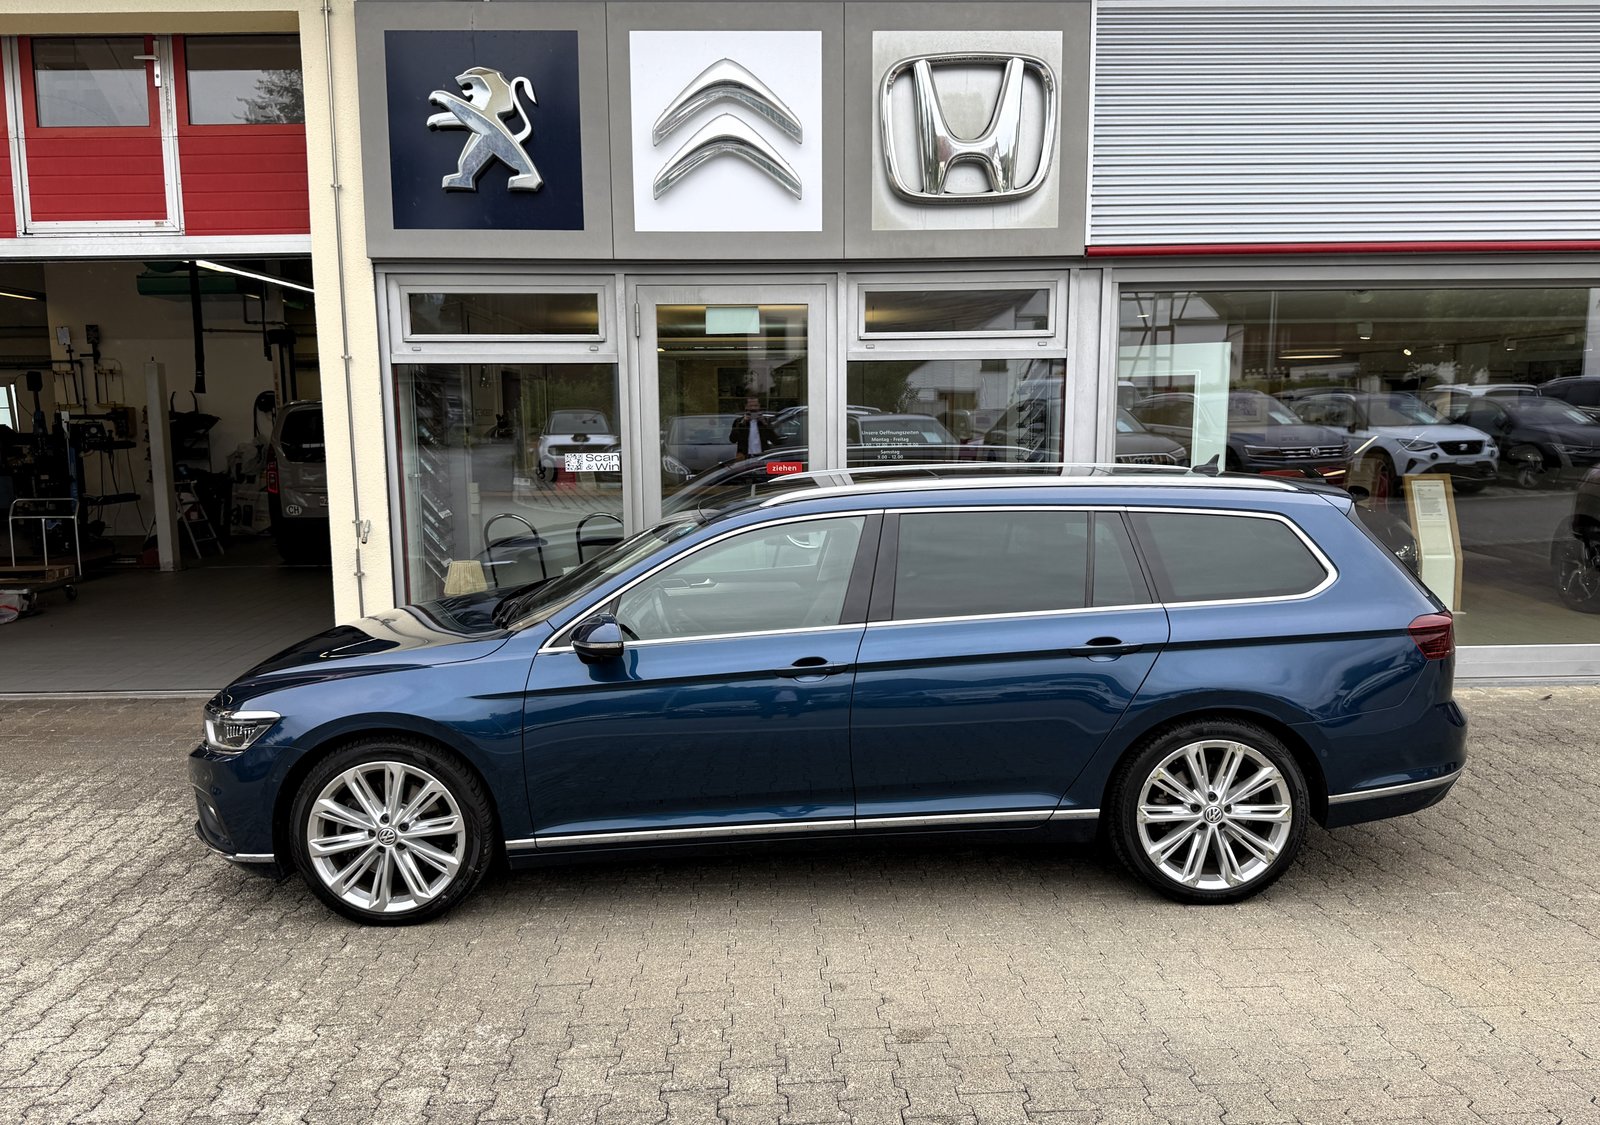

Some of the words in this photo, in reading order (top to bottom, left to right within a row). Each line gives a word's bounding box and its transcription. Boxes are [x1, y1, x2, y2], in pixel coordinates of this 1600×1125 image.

[585, 454, 620, 462] Scan
[595, 462, 620, 470] Win
[287, 505, 301, 514] CH
